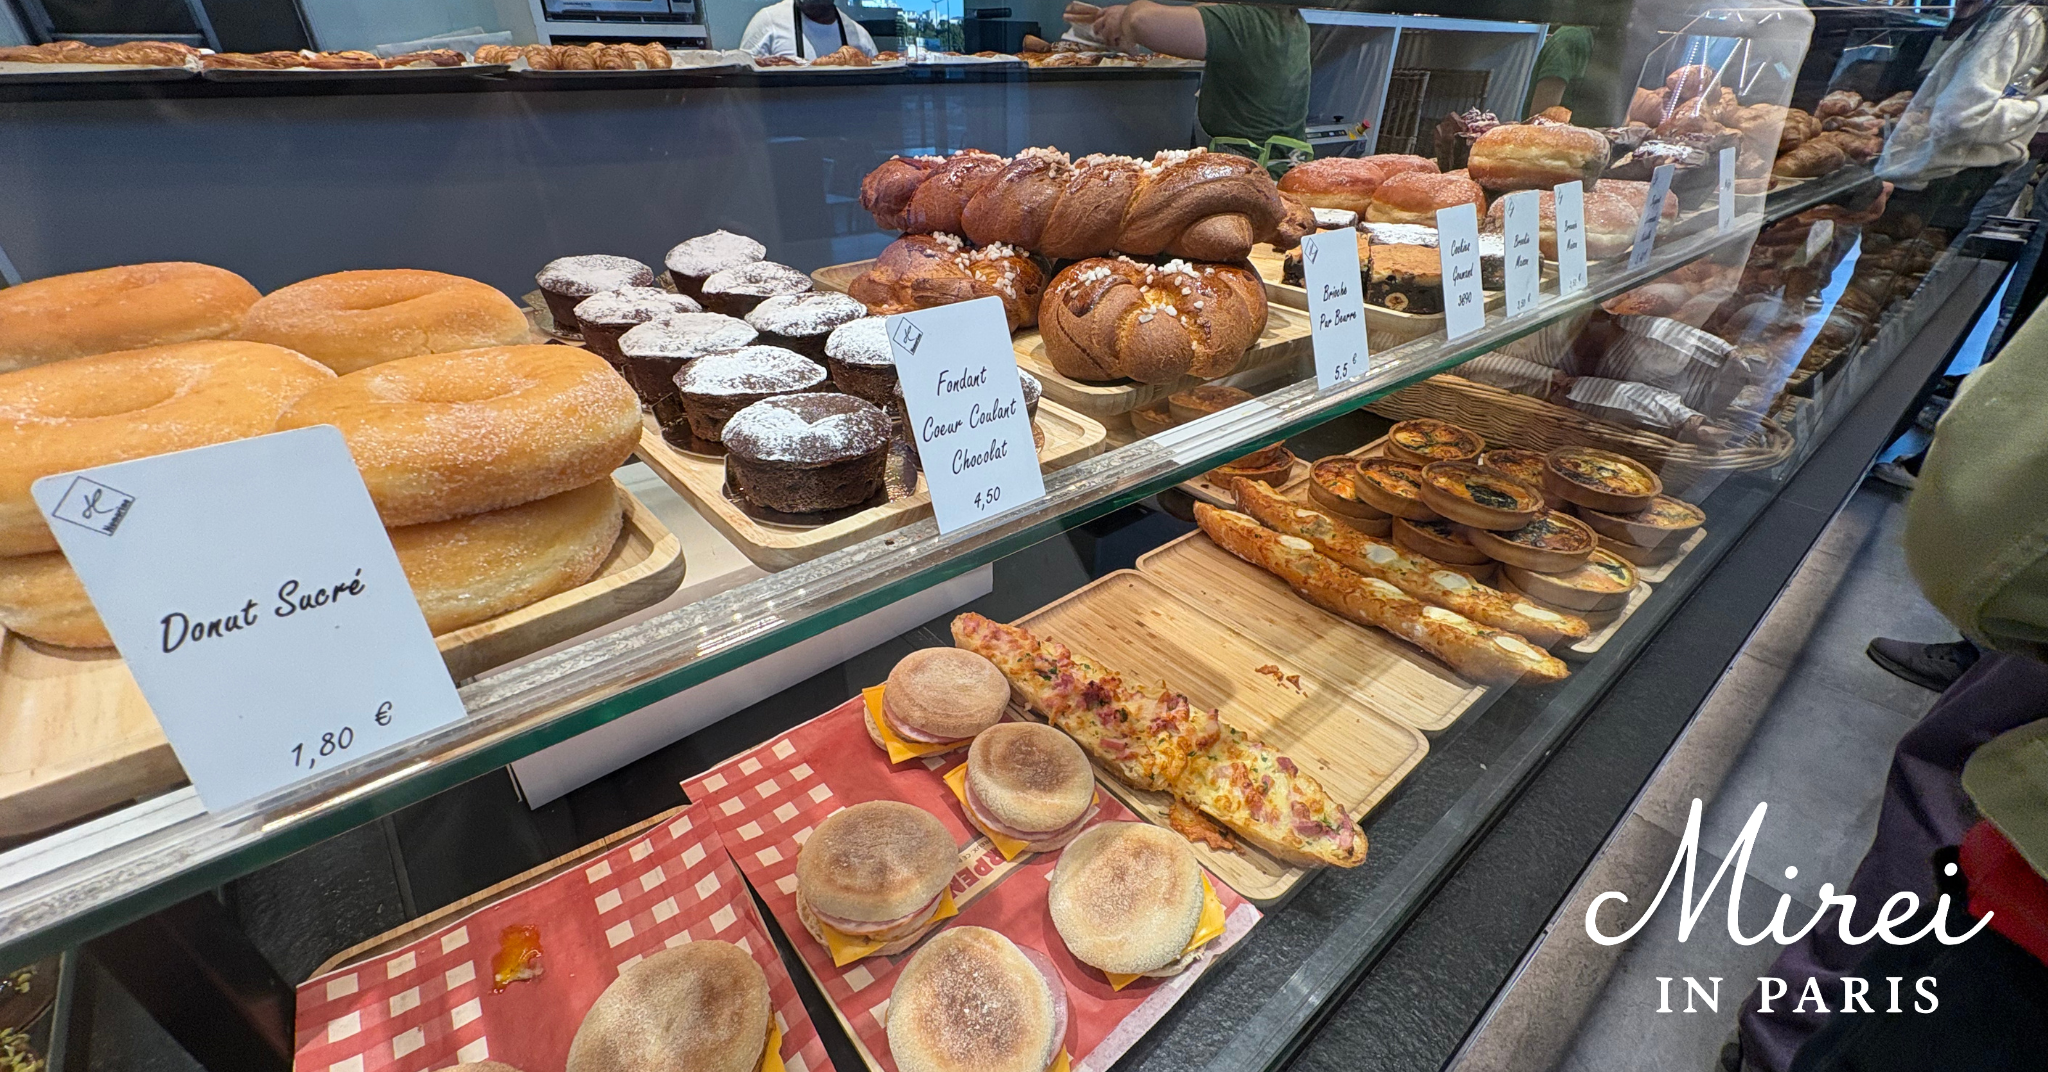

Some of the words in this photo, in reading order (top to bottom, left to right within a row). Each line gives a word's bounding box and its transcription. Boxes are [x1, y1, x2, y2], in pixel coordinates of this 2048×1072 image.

[1323, 281, 1348, 302] Brioche
[1319, 313, 1333, 331] Pur
[1334, 308, 1357, 327] Beurre
[937, 365, 988, 397] Fondant
[922, 416, 964, 443] Coeur
[969, 397, 1017, 429] Coulant
[952, 438, 1008, 475] Chocolat
[974, 486, 1001, 511] 4,50
[160, 598, 259, 653] Donut
[274, 568, 366, 618] Sucré
[291, 726, 354, 769] 1,80
[374, 700, 393, 726] €
